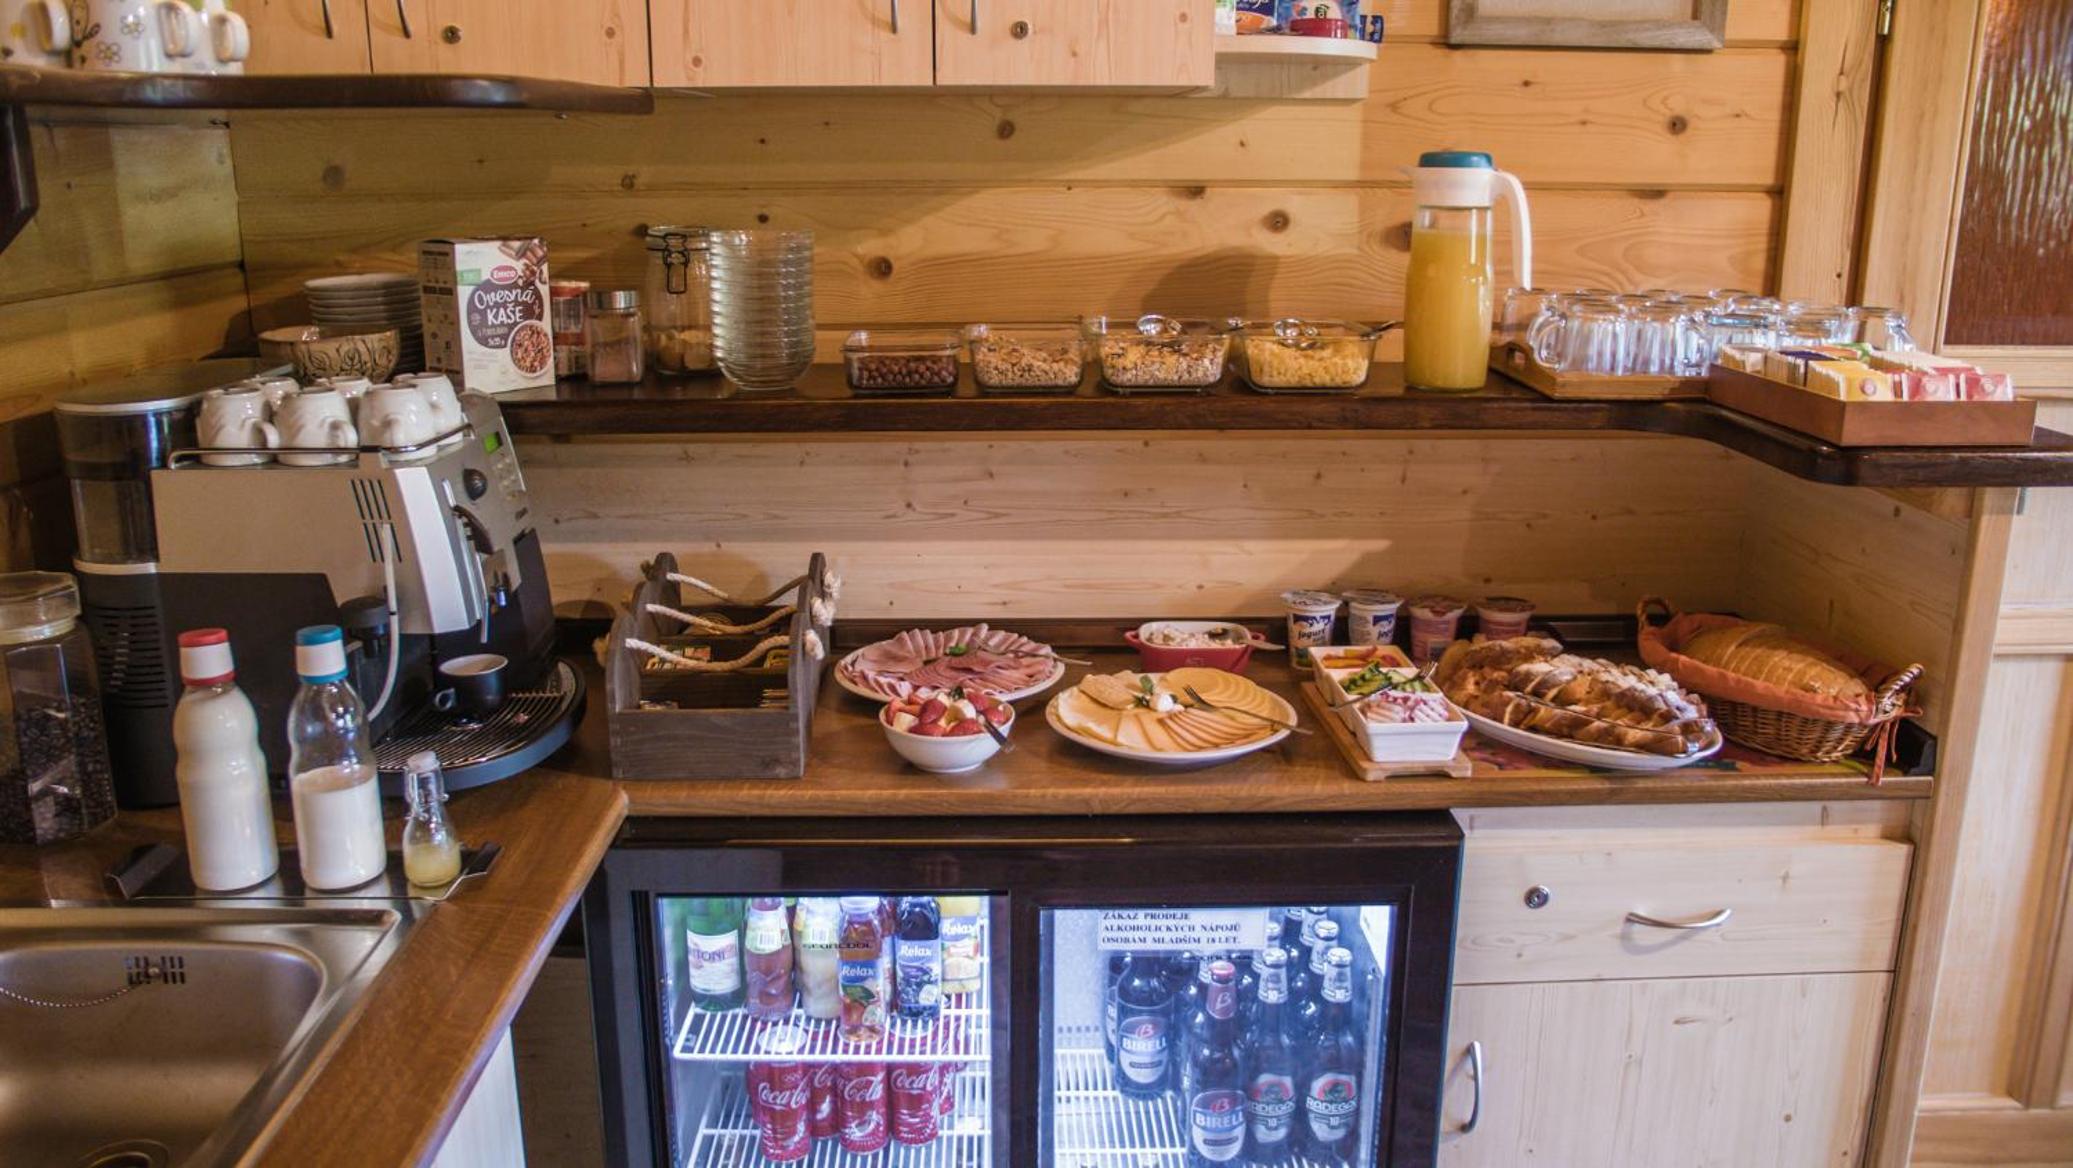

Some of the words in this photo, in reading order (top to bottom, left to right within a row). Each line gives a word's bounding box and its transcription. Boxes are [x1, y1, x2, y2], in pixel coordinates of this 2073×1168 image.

[474, 286, 536, 309] Ovesná
[487, 302, 524, 325] KAŠE
[1103, 911, 1139, 920] ZÁKAZ
[1143, 911, 1190, 920] PRODEJE
[942, 922, 977, 936] Relax
[900, 944, 932, 957] Relax
[841, 964, 875, 977] Relax
[1122, 1036, 1167, 1051] BIRELL
[1195, 1111, 1244, 1128] BIRELL
